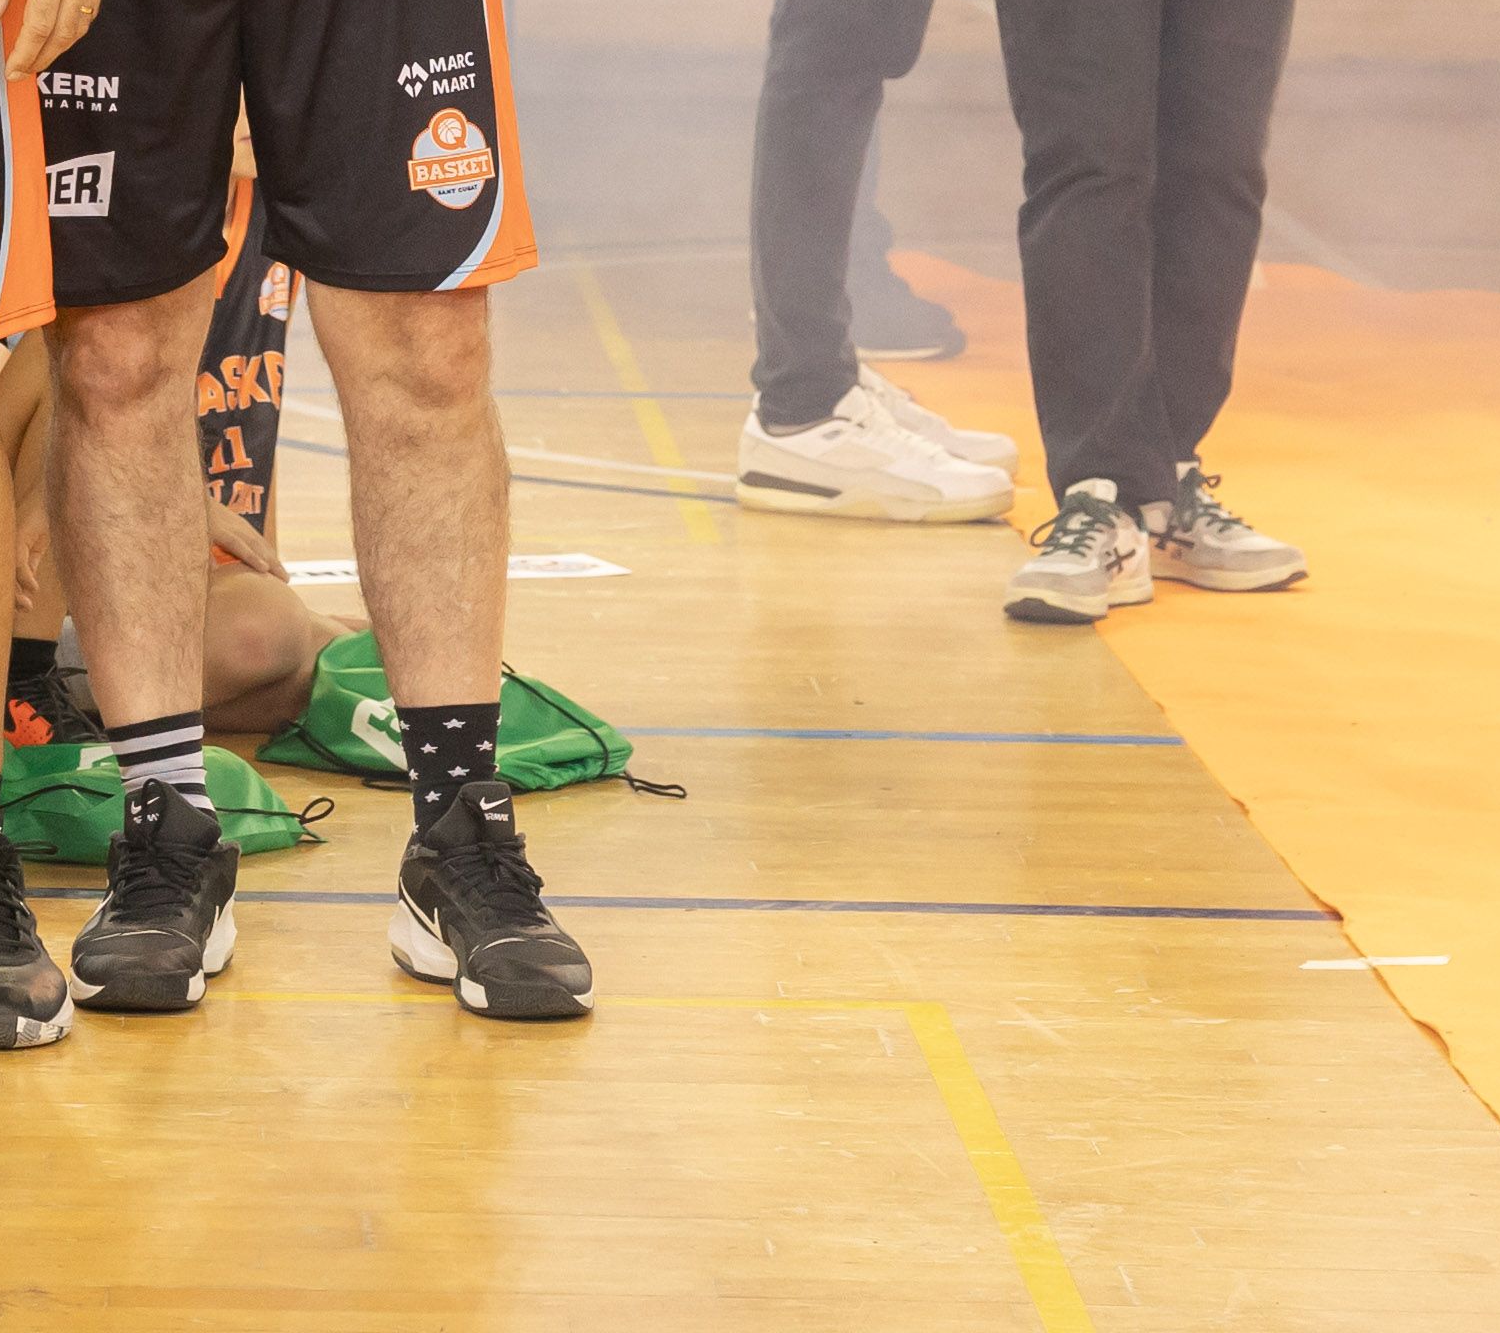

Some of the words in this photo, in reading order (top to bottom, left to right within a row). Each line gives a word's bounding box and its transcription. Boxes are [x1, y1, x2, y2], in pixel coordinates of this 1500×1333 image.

[429, 51, 475, 74] MARC
[432, 73, 476, 96] MART
[44, 99, 118, 113] HARMA
[415, 155, 489, 183] BASKET
